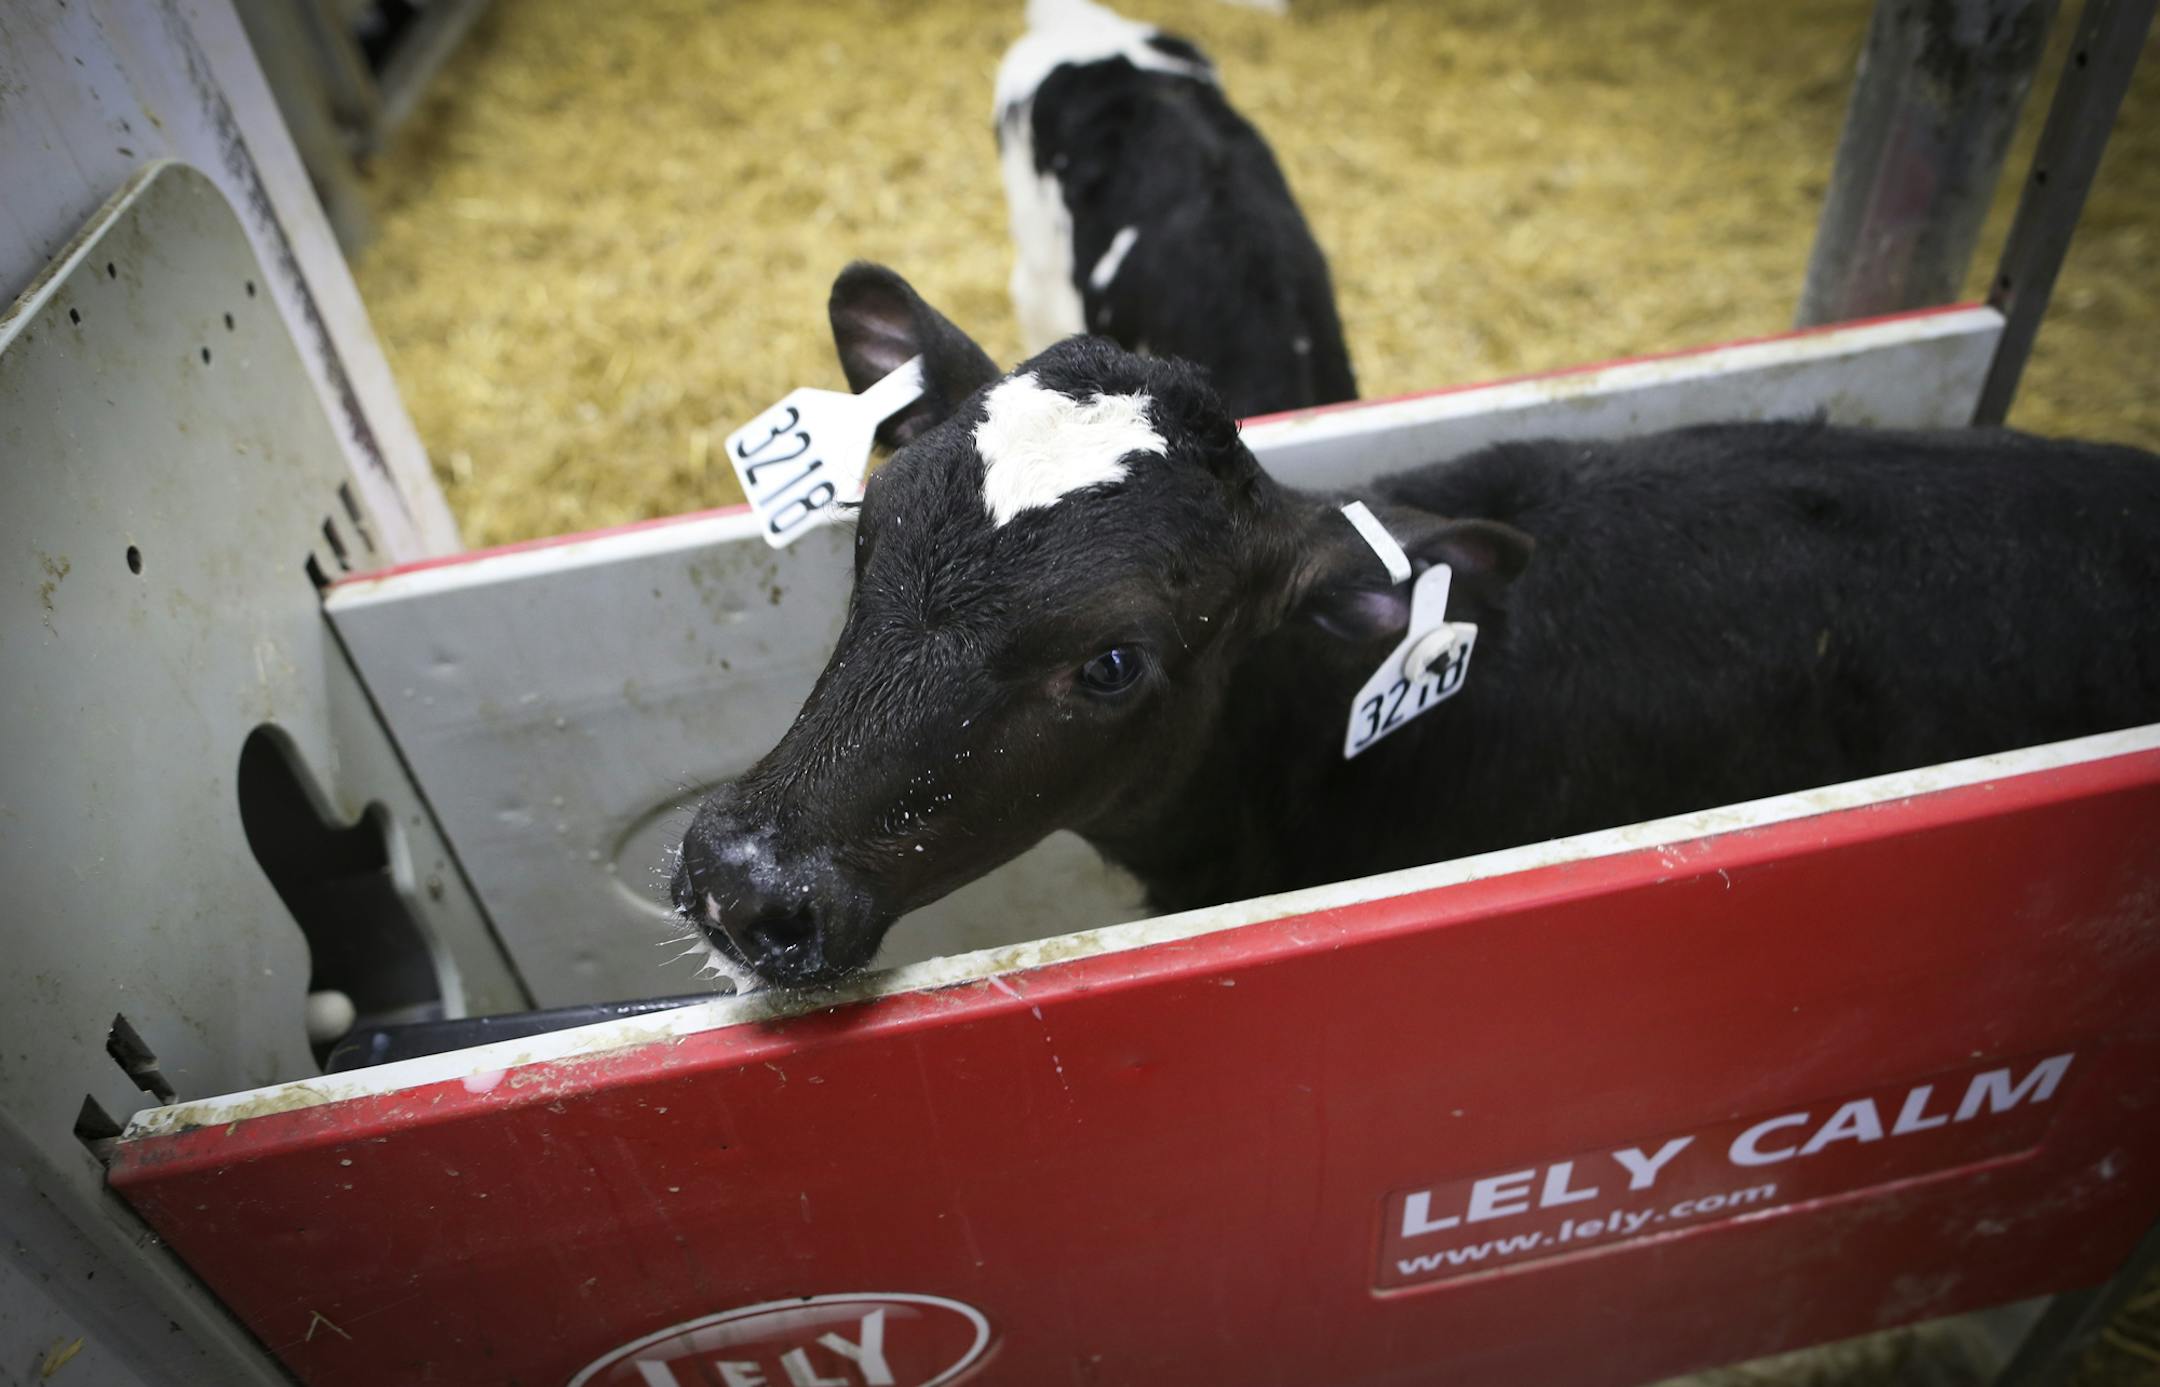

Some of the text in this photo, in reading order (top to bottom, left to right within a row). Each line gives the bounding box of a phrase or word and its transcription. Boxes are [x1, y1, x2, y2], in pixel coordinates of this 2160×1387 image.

[737, 406, 835, 534] 3218
[1401, 1052, 2075, 1238] LELY CALM
[1397, 1182, 1777, 1275] www.lely.com
